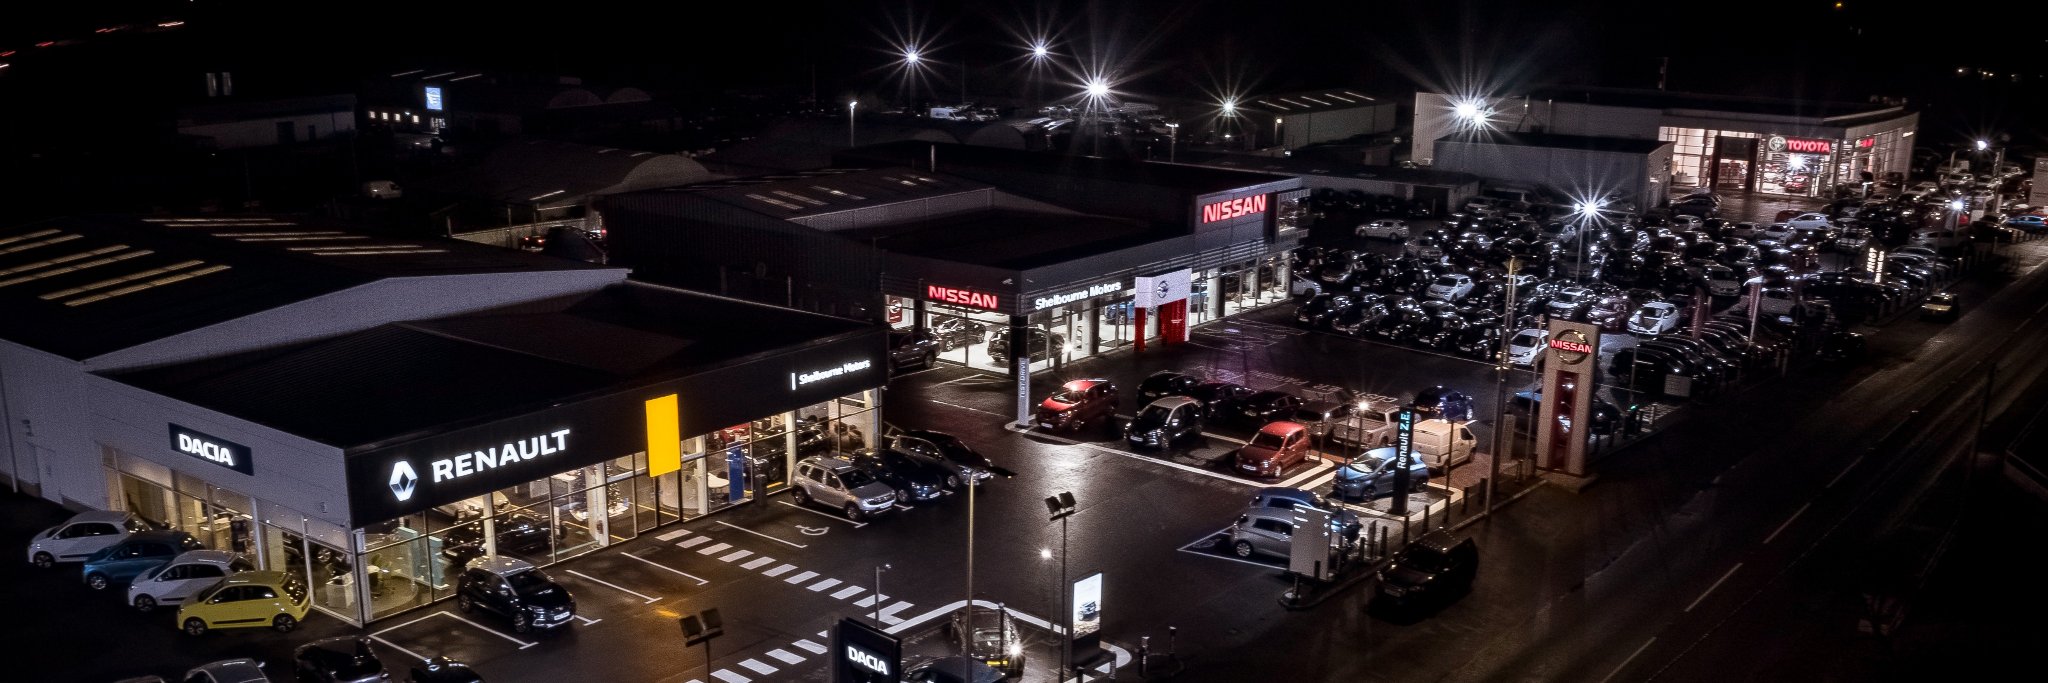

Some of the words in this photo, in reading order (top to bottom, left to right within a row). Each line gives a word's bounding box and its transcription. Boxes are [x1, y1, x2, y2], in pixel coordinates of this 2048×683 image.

[1787, 139, 1831, 152] TOYOTA
[1203, 193, 1267, 224] NISSAN
[928, 285, 998, 309] NISSAN
[1035, 289, 1089, 311] Shelbourne
[1089, 281, 1122, 298] Motors
[1551, 339, 1593, 354] NISSAN
[843, 359, 871, 374] Motors
[1400, 411, 1411, 431] Z.E.
[178, 433, 234, 466] DACIA
[432, 429, 571, 484] RENAULT
[1397, 432, 1409, 469] Renault
[847, 645, 889, 675] DACIA
